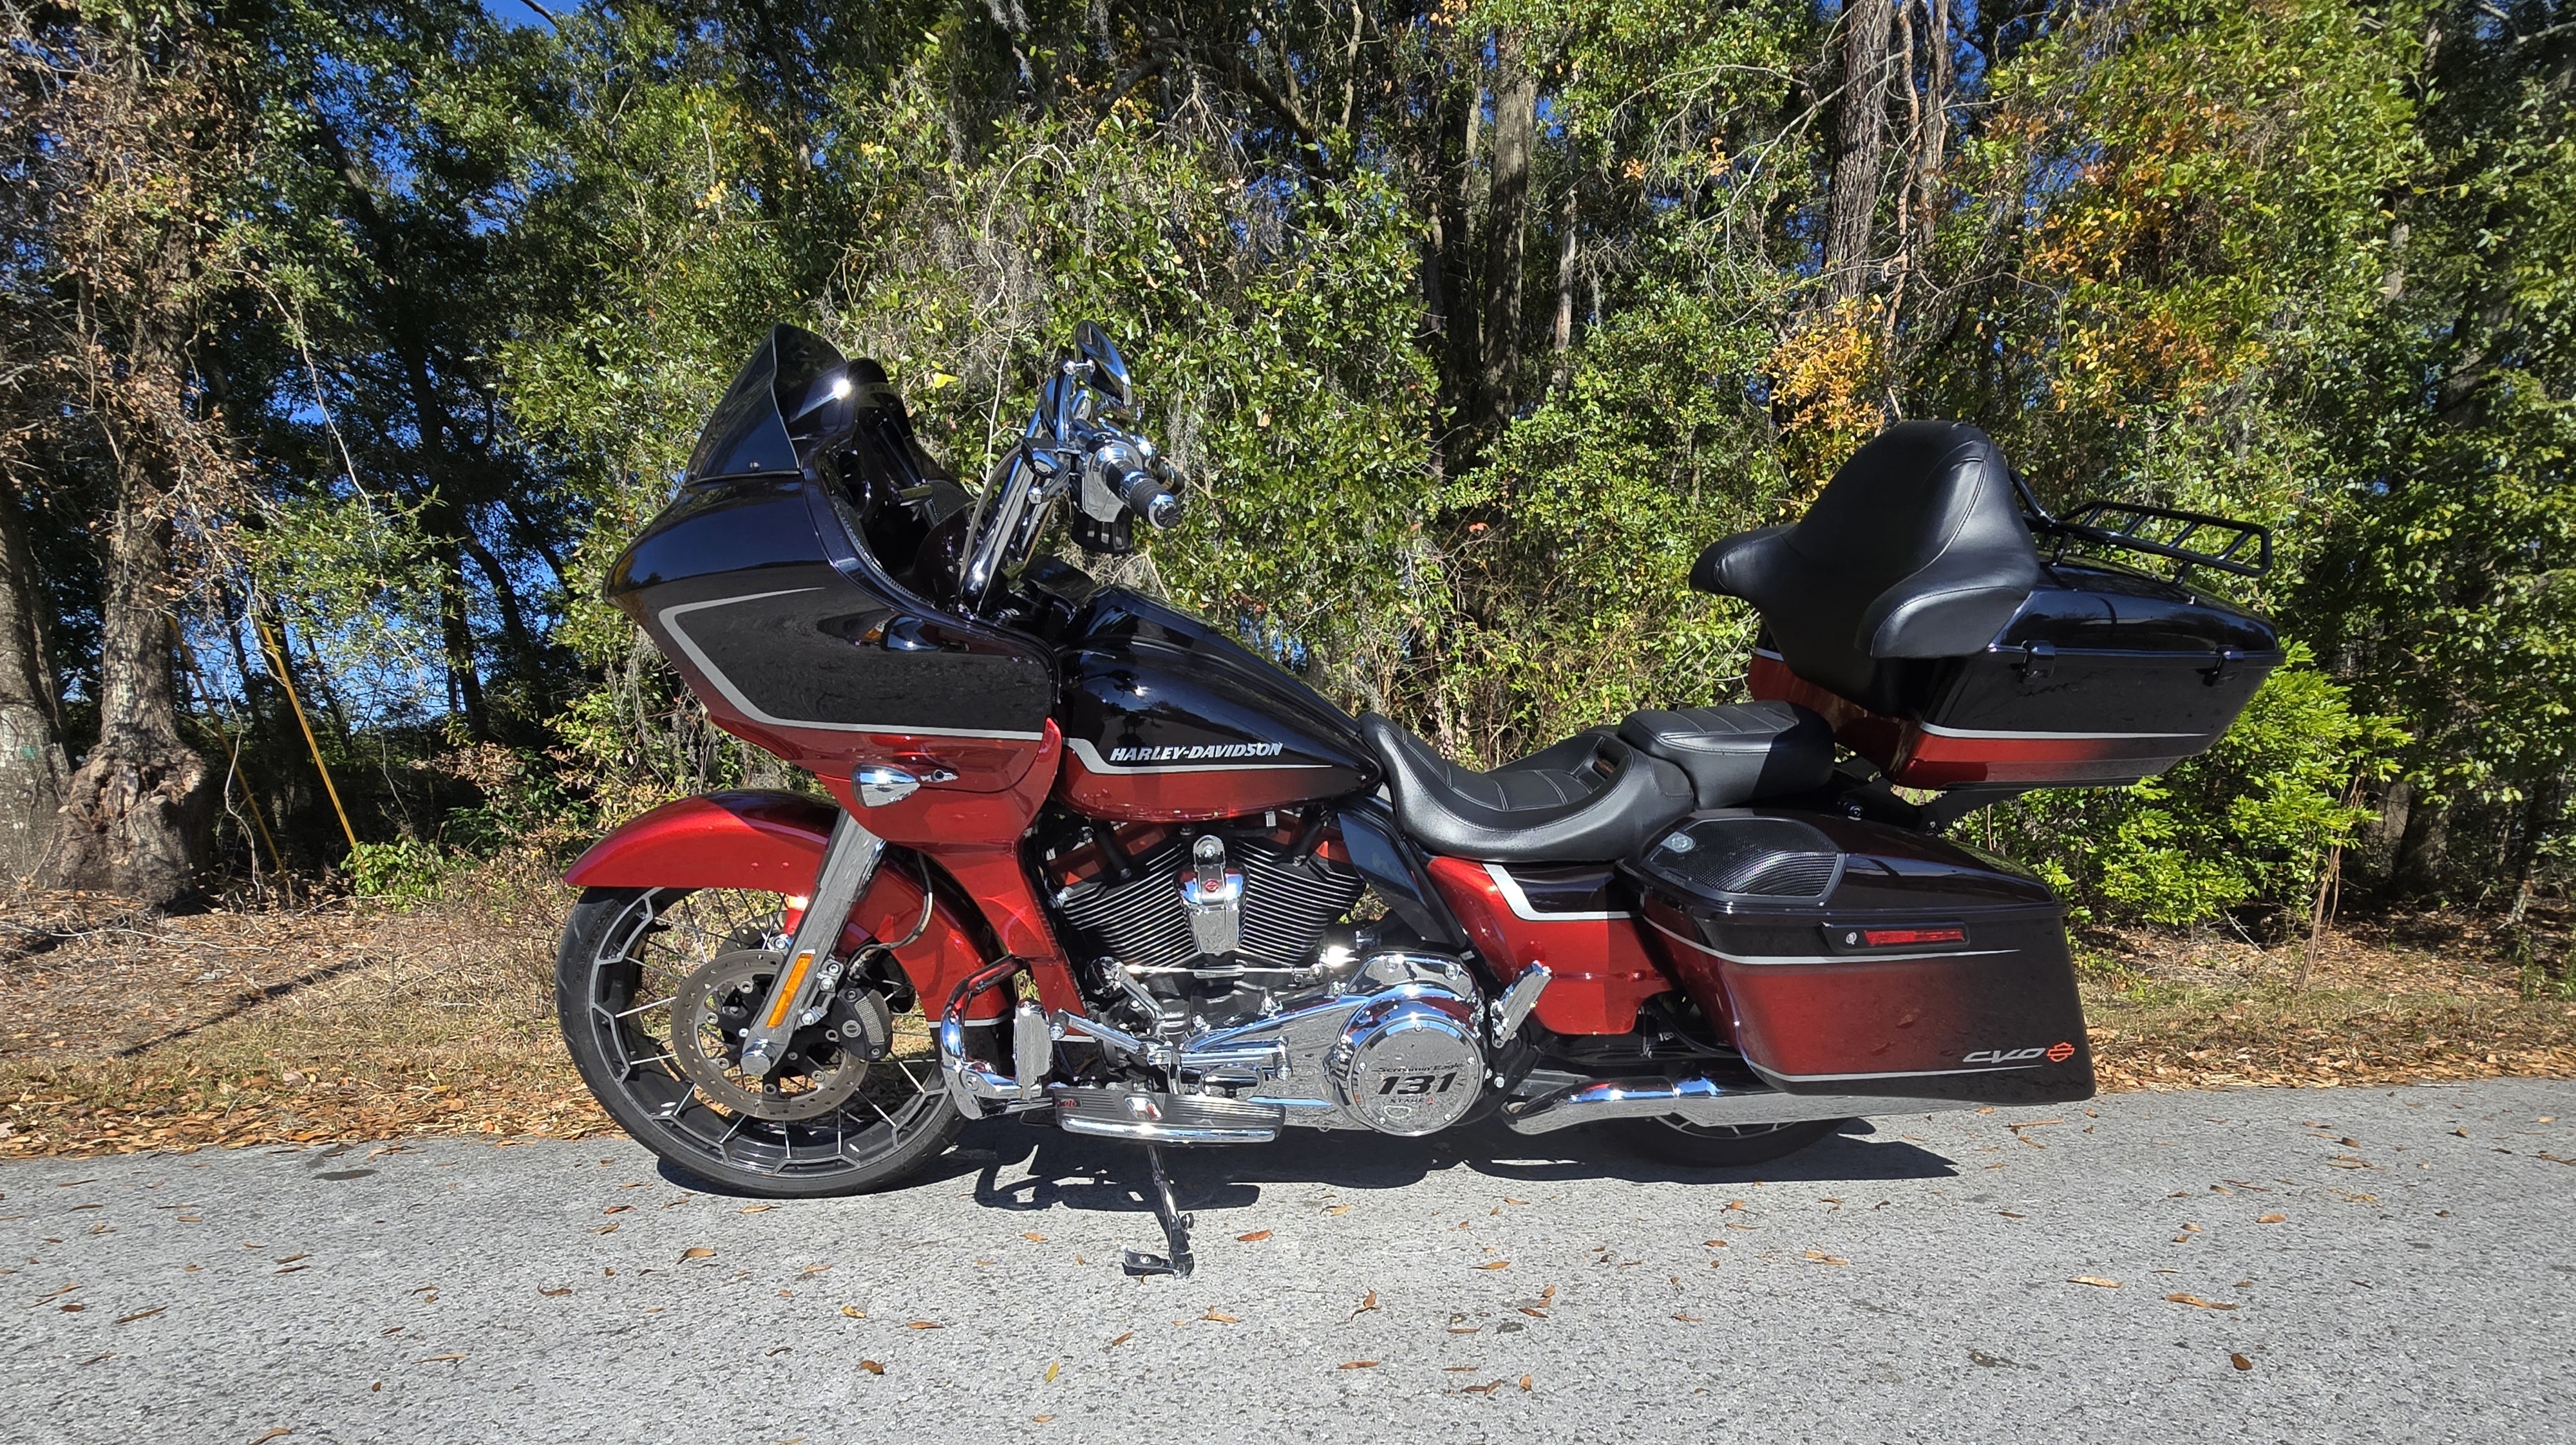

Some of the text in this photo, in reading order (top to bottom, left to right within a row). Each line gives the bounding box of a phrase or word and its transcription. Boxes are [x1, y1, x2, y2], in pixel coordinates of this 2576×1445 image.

[1110, 741, 1283, 762] HARLEY-DAVIDSON
[1962, 1048, 2046, 1063] CVO
[1378, 1072, 1457, 1095] 131
